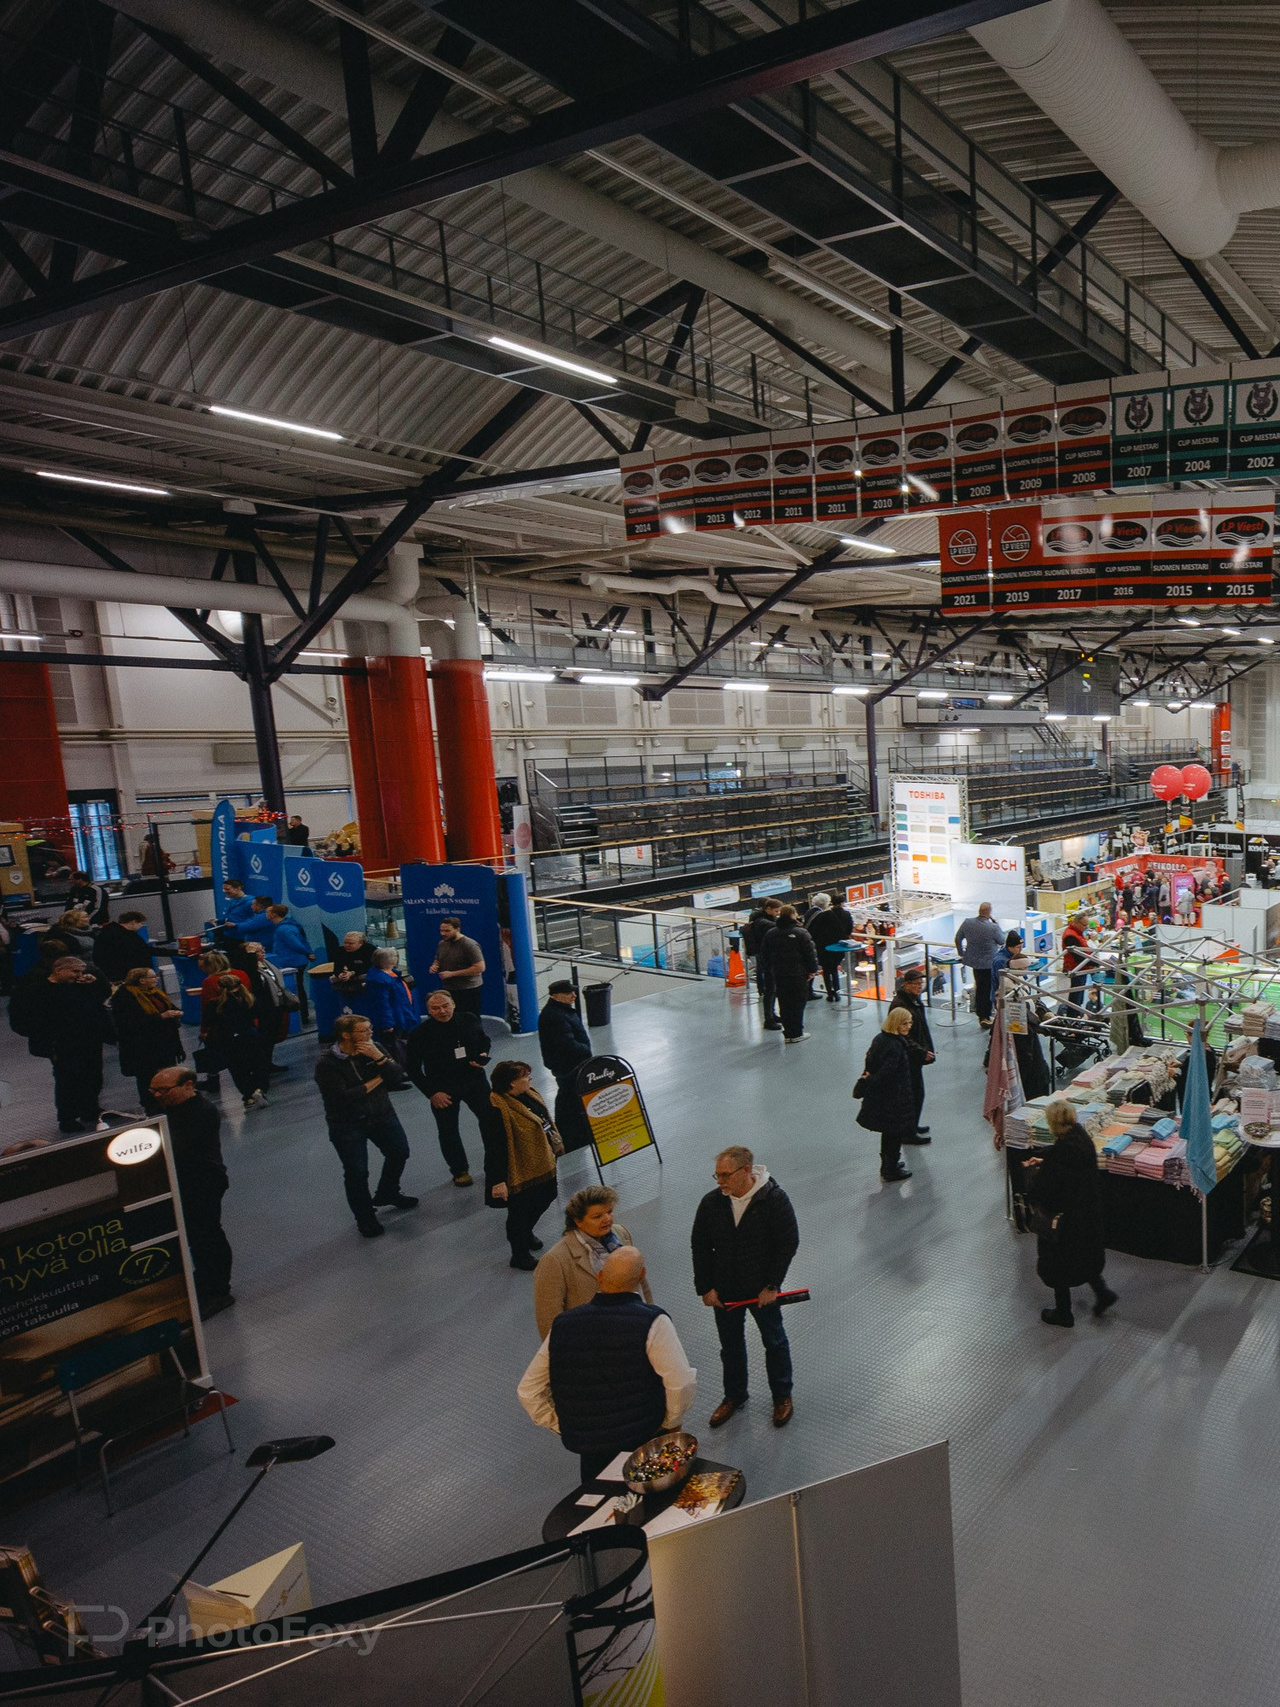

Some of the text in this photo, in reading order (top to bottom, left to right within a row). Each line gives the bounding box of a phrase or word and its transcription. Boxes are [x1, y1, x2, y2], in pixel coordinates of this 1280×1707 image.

[1178, 436, 1219, 447] CUP MESTARI
[1240, 435, 1254, 443] CUP
[1133, 443, 1160, 452] MESTARI
[1066, 450, 1102, 460] CUP MESTARI
[1007, 456, 1054, 468] SUOMEN MESTARI
[1185, 460, 1211, 472] 2004
[1247, 456, 1274, 468] 2002
[974, 465, 996, 473] MESTARI
[1128, 466, 1152, 478] 2007
[1072, 472, 1096, 484] 2008
[1020, 478, 1042, 490] 2009
[970, 486, 991, 497] 2009
[828, 504, 846, 514] 2011
[873, 499, 892, 510] 2010
[744, 509, 762, 519] 2012
[785, 507, 802, 516] 2011
[707, 513, 726, 524] 2013
[635, 523, 651, 533] 2014
[1117, 526, 1142, 536] Viesti
[1161, 525, 1172, 534] LP
[1222, 521, 1264, 532] LP Viesti
[1002, 540, 1030, 550] LP VIESTI
[1153, 564, 1180, 572] SUOMEN
[1220, 562, 1233, 570] CUP
[1019, 570, 1042, 578] MESTARI
[942, 576, 965, 584] SUOMEN
[1058, 589, 1082, 600] 2017
[1114, 587, 1134, 596] 2016
[1166, 586, 1193, 596] 2015
[1226, 585, 1254, 596] 2015
[954, 594, 976, 606] 2021
[1006, 591, 1030, 602] 2019
[908, 790, 946, 800] TOSHIBA
[976, 858, 1018, 872] BOSCH
[116, 1142, 152, 1158] wilfa
[16, 1219, 124, 1264] kotona
[78, 1235, 128, 1264] olla
[135, 1254, 154, 1276] 7
[88, 1274, 100, 1285] ja
[24, 1302, 80, 1327] takuulla
